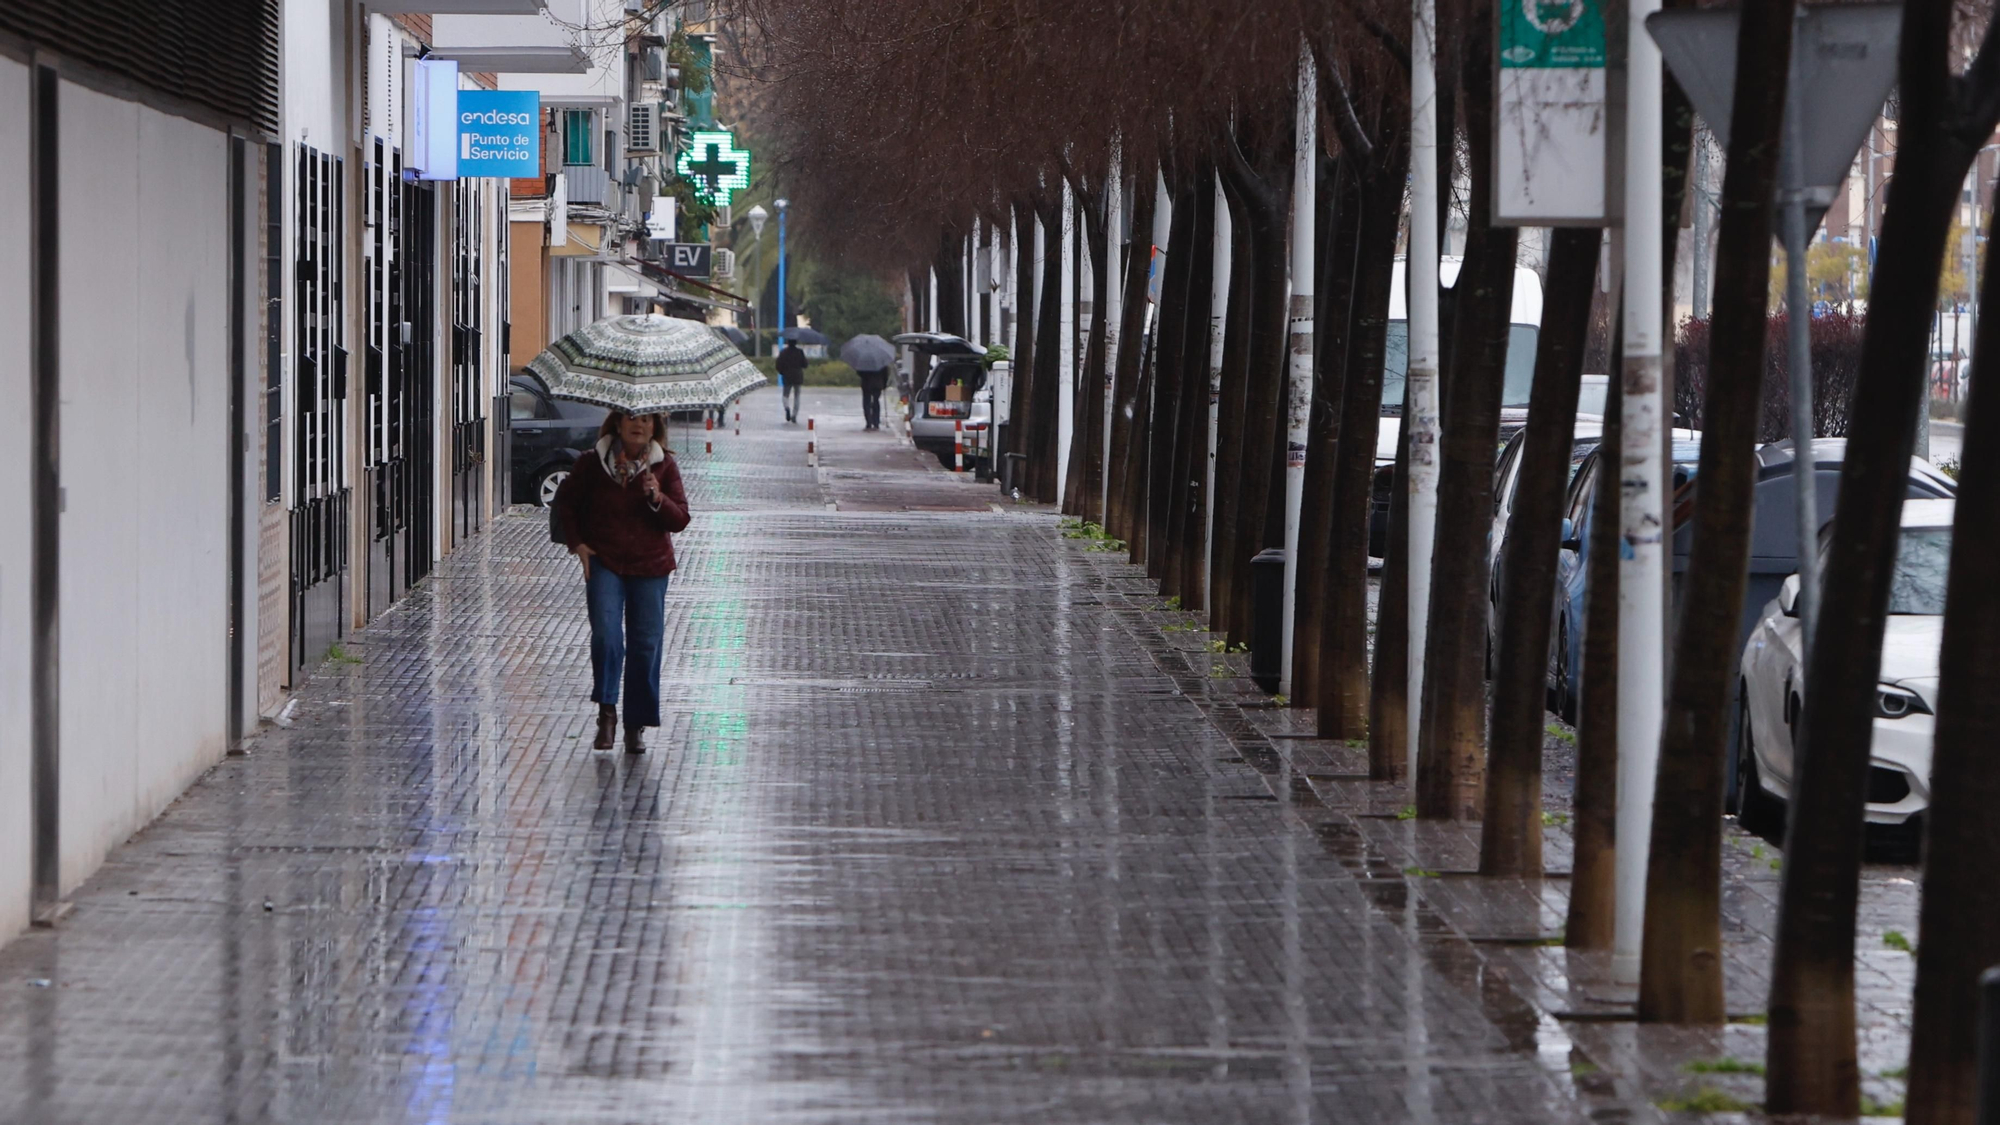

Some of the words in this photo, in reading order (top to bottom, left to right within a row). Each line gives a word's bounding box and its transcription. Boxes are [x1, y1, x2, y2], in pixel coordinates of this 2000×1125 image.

[461, 109, 530, 125] endesa
[471, 133, 510, 145] Punto
[513, 133, 529, 145] de
[470, 147, 529, 160] Servicio
[675, 246, 702, 266] EV
